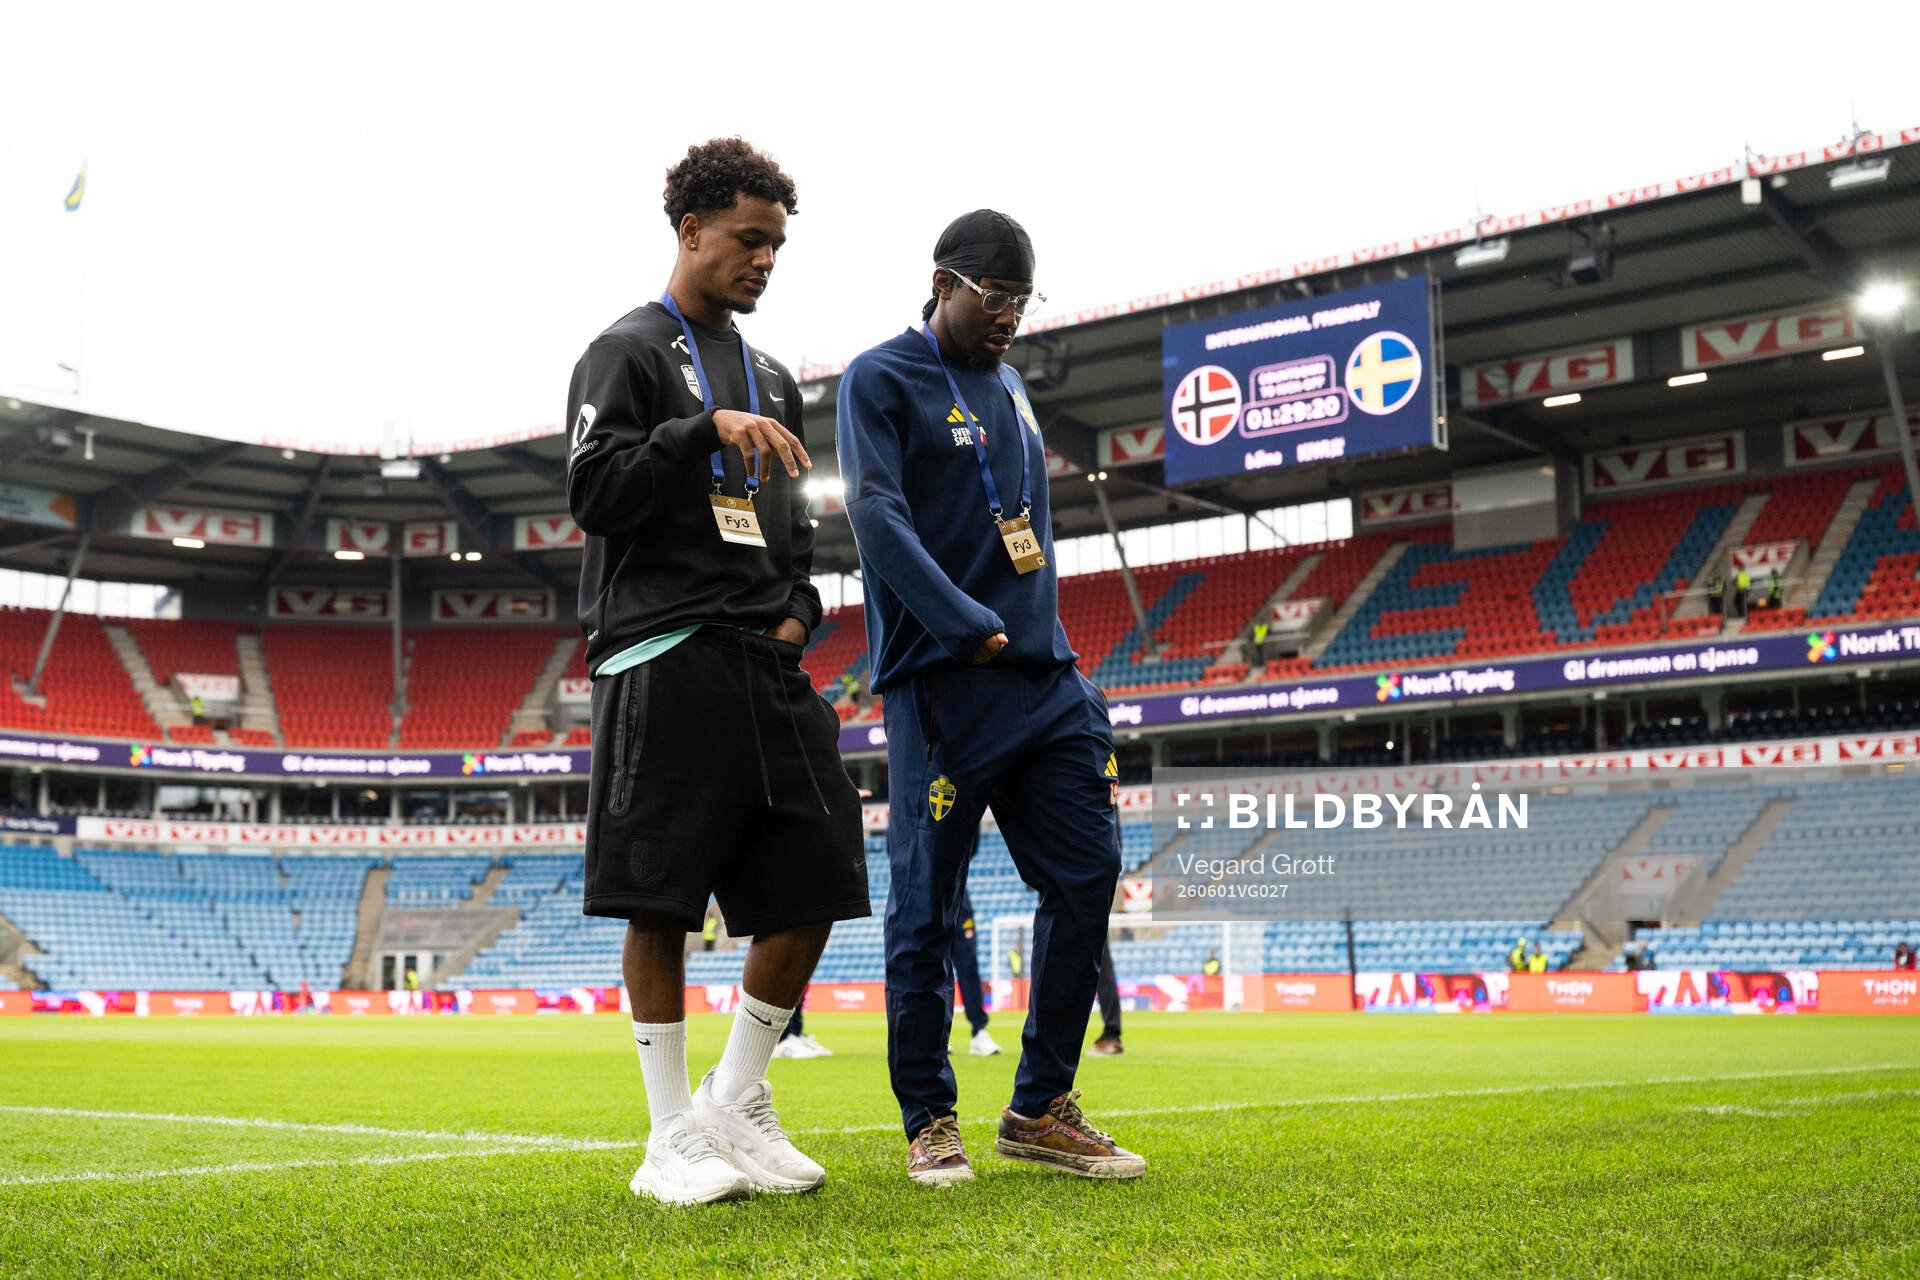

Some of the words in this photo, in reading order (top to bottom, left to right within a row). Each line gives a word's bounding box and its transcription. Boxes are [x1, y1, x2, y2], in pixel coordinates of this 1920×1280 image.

[1696, 304, 1854, 365] VG
[1476, 344, 1618, 401] VG
[1246, 396, 1341, 430] 01:29:20
[951, 426, 987, 438] SVENA
[954, 436, 974, 447] SPEL
[1593, 435, 1738, 490] VG
[1363, 484, 1454, 523] VG
[146, 506, 261, 544] VG
[724, 515, 750, 529] Fy3
[1012, 538, 1032, 554] Fy3
[276, 588, 391, 619] VG
[1840, 630, 1900, 657] Norsk
[1563, 659, 1586, 681] Gi
[1672, 651, 1697, 671] en
[1698, 647, 1759, 673] sjanse
[1403, 672, 1451, 696] Norsk
[1451, 667, 1515, 693] Tipping
[1647, 749, 1725, 770] VG
[1740, 742, 1822, 767] VG
[1838, 735, 1920, 761] VG
[1547, 980, 1593, 996] THON
[1863, 979, 1917, 996] THON
